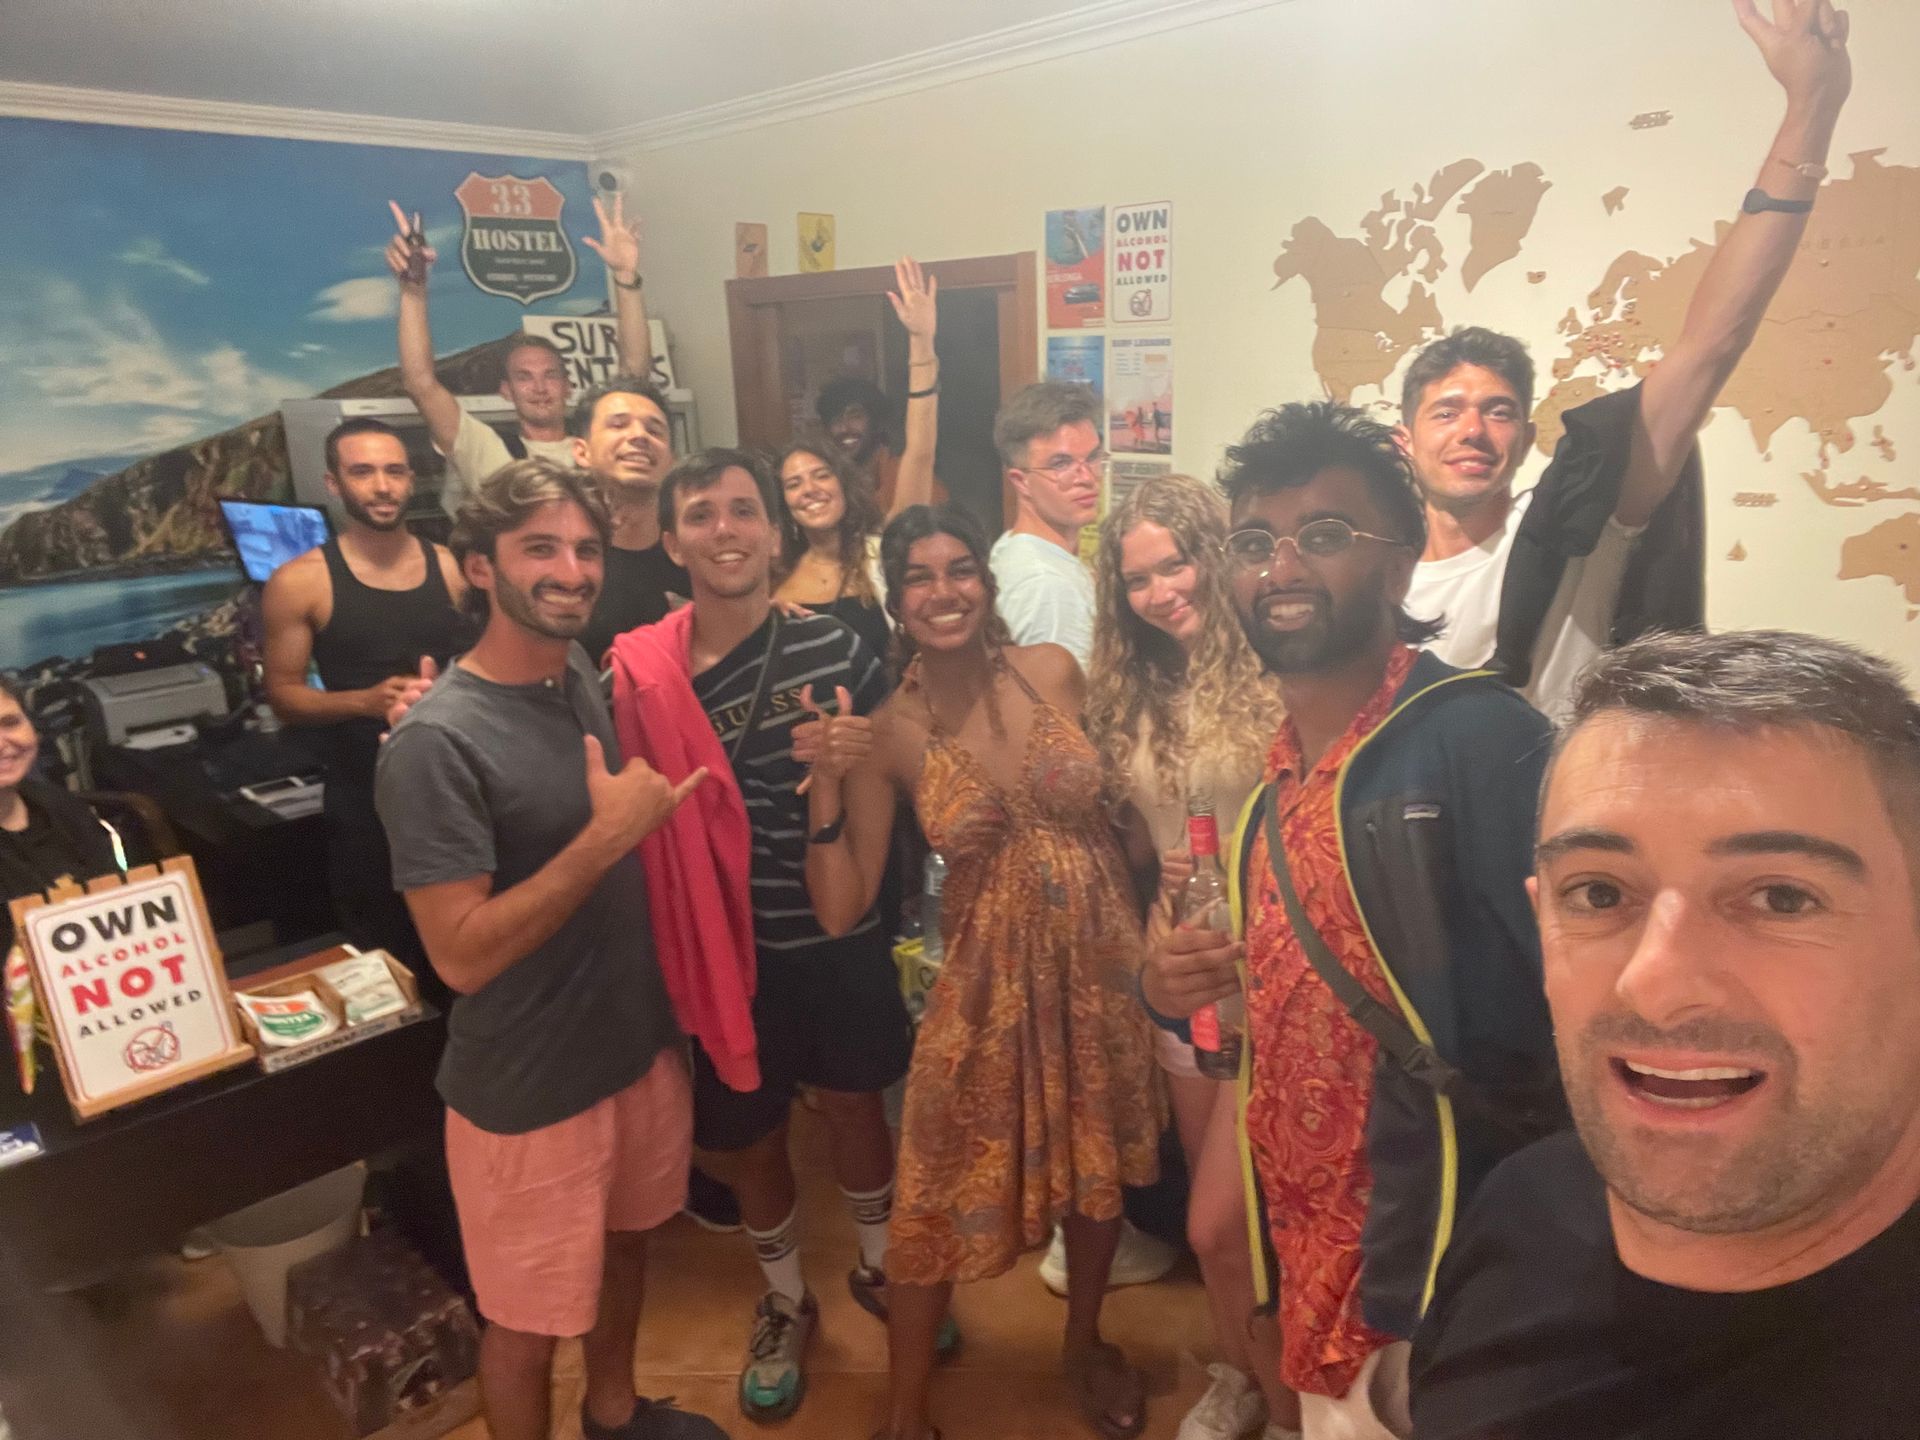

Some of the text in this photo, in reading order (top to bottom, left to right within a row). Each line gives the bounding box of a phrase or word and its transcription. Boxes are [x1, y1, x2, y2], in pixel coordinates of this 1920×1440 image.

[491, 183, 532, 215] 33
[1116, 209, 1168, 233] OWN
[472, 229, 563, 252] HOSTEL
[1117, 249, 1165, 271] NOT
[1116, 274, 1168, 286] ALLOWED
[552, 321, 620, 355] SUR
[51, 896, 178, 953] OWN
[62, 931, 185, 978] ALCOHOL
[71, 954, 185, 1015] NOT
[80, 990, 201, 1037] ALLOWED
